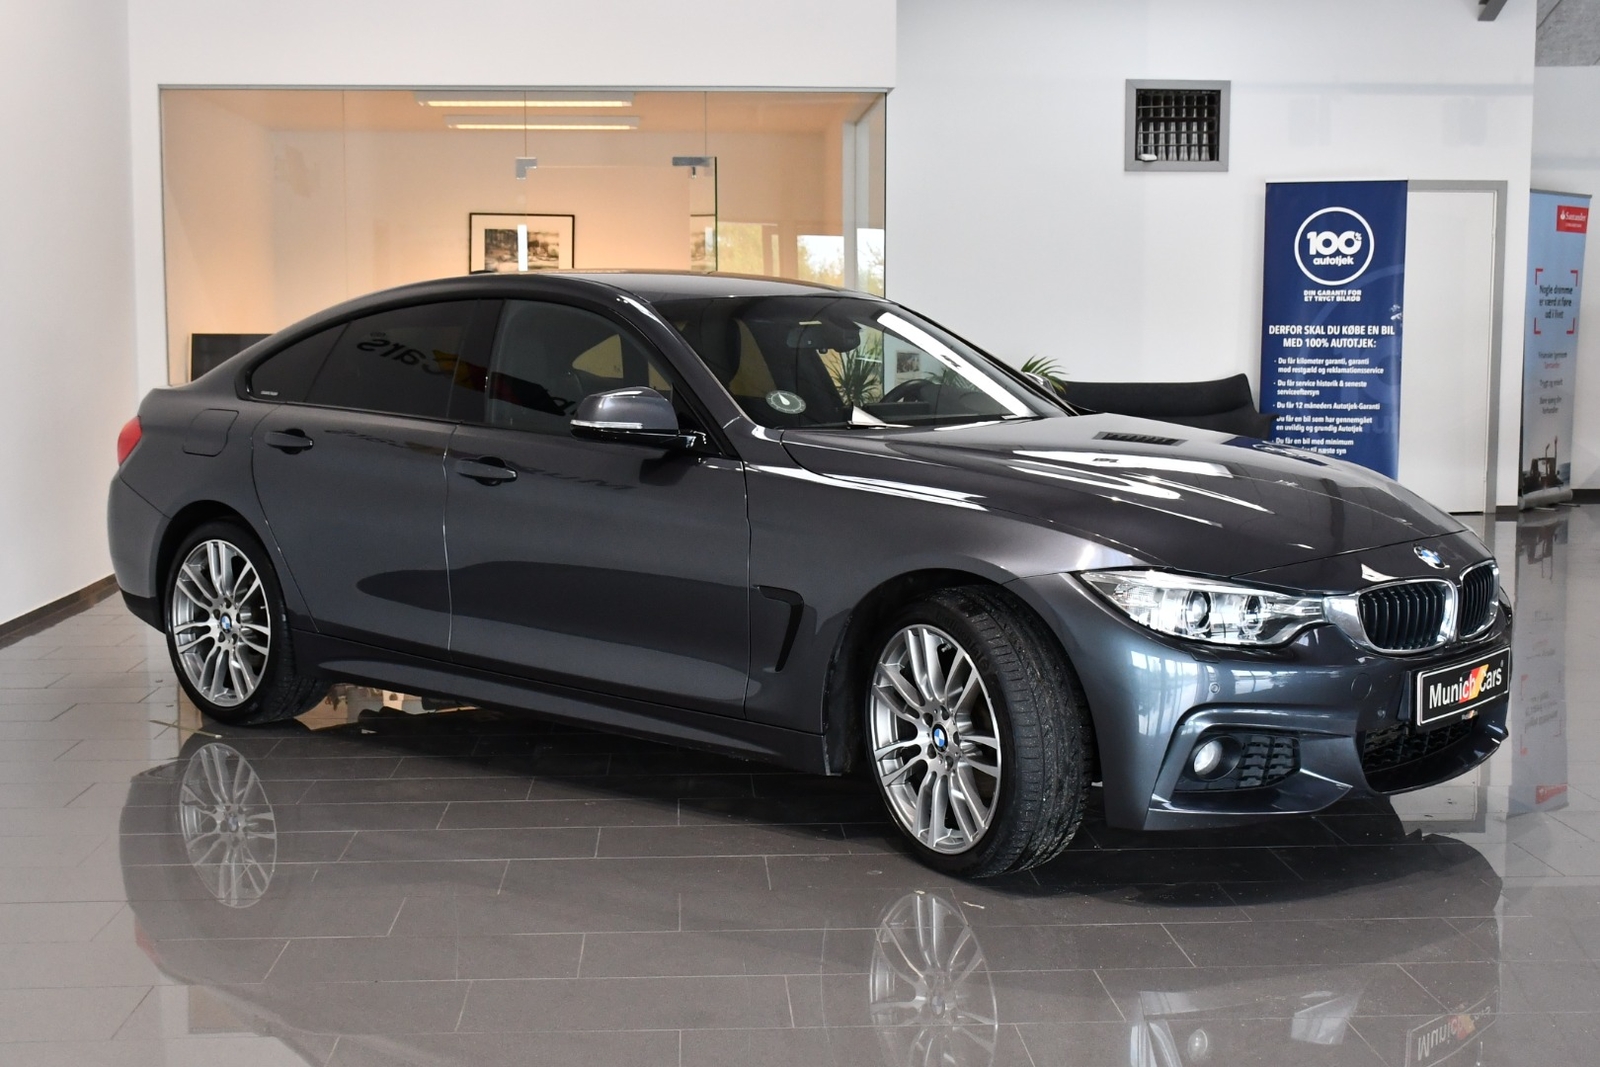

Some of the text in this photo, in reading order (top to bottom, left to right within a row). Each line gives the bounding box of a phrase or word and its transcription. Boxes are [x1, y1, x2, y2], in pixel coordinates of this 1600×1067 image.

[1313, 256, 1354, 266] autotjek
[1268, 325, 1395, 335] DERFOR SKAL DU KØBE EN BIL
[1283, 338, 1377, 348] MED 100% AUTOTJEK:
[1325, 358, 1347, 366] garanti,
[1348, 358, 1370, 366] garanti
[1292, 366, 1317, 374] restgæld
[1277, 389, 1320, 397] serviceeftersyn
[1333, 403, 1380, 411] Autotjek-Garanti
[1336, 417, 1372, 425] gennemgået
[1314, 425, 1337, 433] grundig
[1336, 448, 1347, 456] syn
[1429, 674, 1476, 709] Munich
